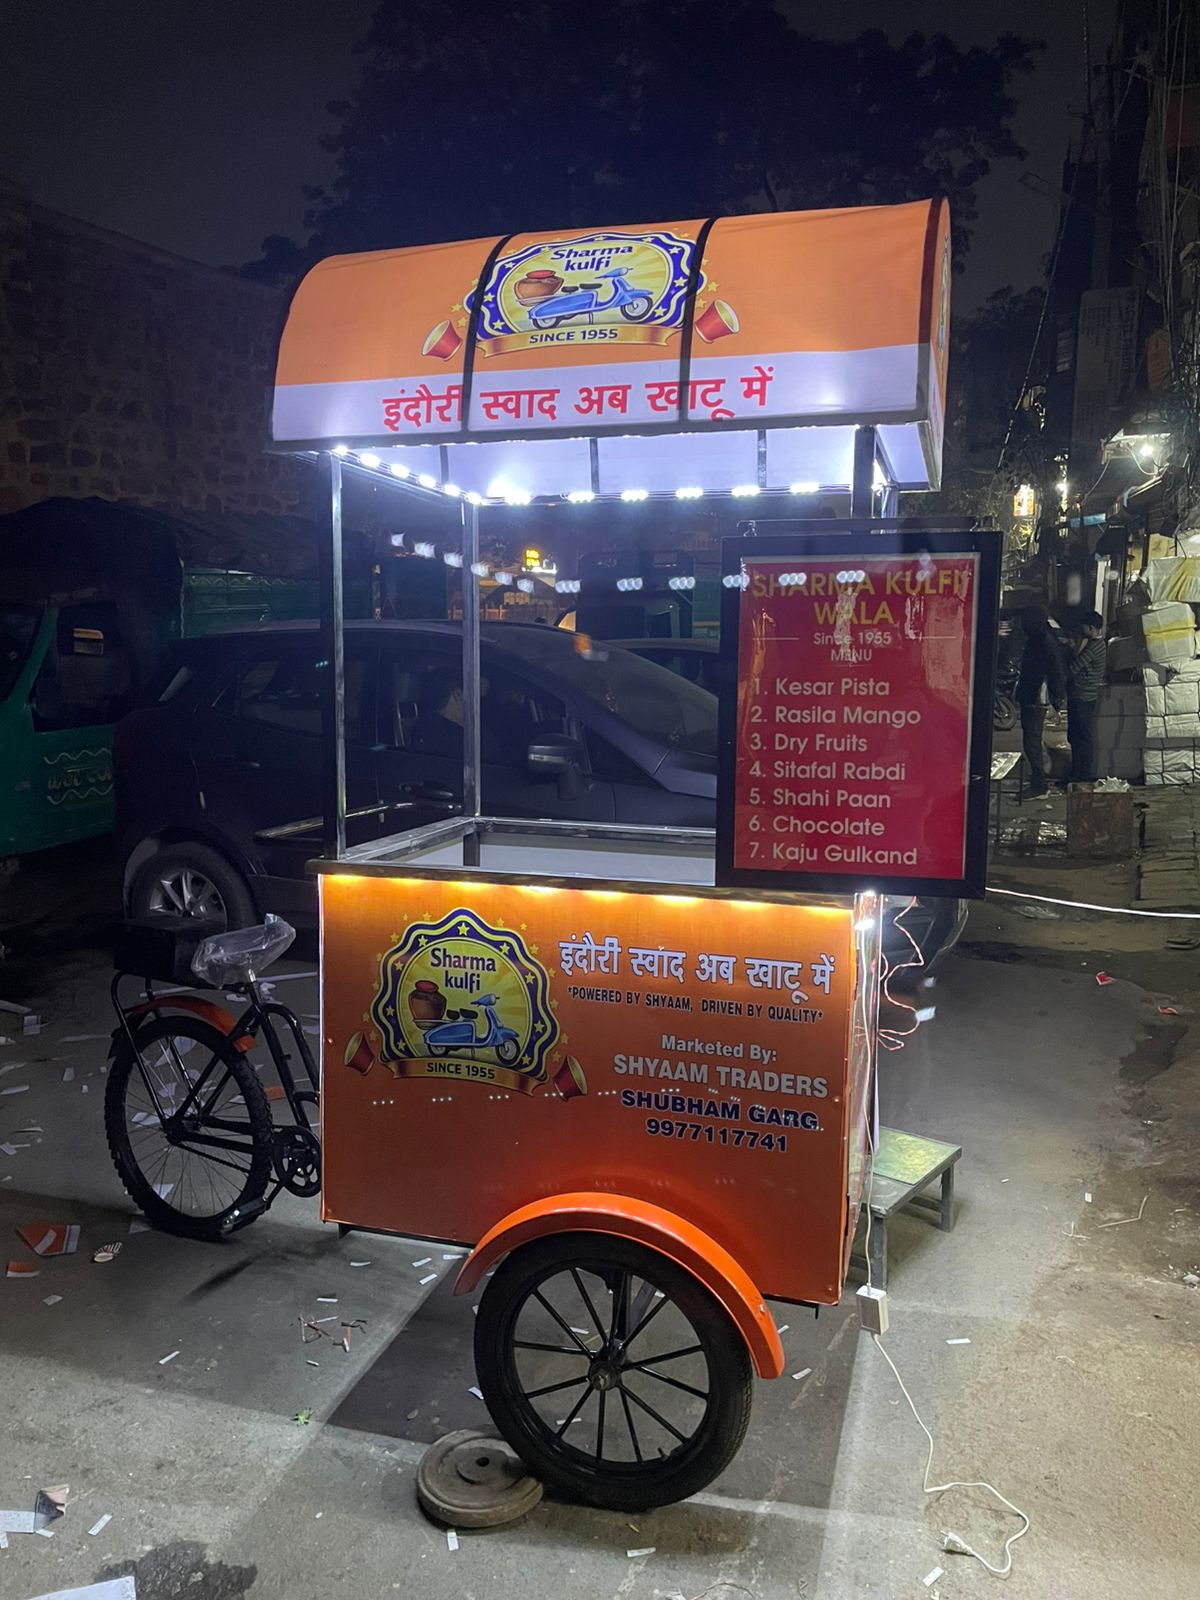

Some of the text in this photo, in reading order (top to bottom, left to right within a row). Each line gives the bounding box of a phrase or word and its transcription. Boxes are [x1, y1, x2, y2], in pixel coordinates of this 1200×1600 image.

[550, 244, 634, 261] Sharma
[563, 255, 611, 272] kulfi
[528, 328, 619, 344] SINCE 1955
[382, 365, 776, 432] इंदौरी स्वाद अब खाटू में
[813, 601, 894, 625] WALA
[813, 632, 892, 645] Since 1955
[830, 649, 872, 662] MENU
[754, 679, 890, 696] 1. Kesar Pista
[750, 706, 921, 729] 2. Rasila Mango
[750, 734, 868, 755] 3. Dry Fruits
[749, 761, 906, 781] 4. Sitafal Rabdi
[749, 788, 891, 808] 5. Shahi Paan
[748, 815, 885, 836] 6. Chocolate
[749, 842, 918, 866] 7. Kaju Gulkand
[430, 947, 497, 972] Sharma
[559, 932, 622, 976] इंदौरी
[695, 953, 736, 984] अब
[745, 956, 809, 1004] खाटू
[811, 953, 836, 994] में
[444, 970, 481, 993] kulfi
[626, 991, 640, 1005] BY
[645, 994, 693, 1013] SHYAAM,
[701, 999, 743, 1015] DRIVEN
[747, 1003, 763, 1017] BY
[661, 1034, 777, 1065] Marketed By:
[427, 1062, 495, 1079] SINCE 1955
[614, 1054, 829, 1098] SHYAAM TRADERS
[622, 1089, 818, 1129] SHUBHAM GARG
[646, 1118, 787, 1152] 9977117741
